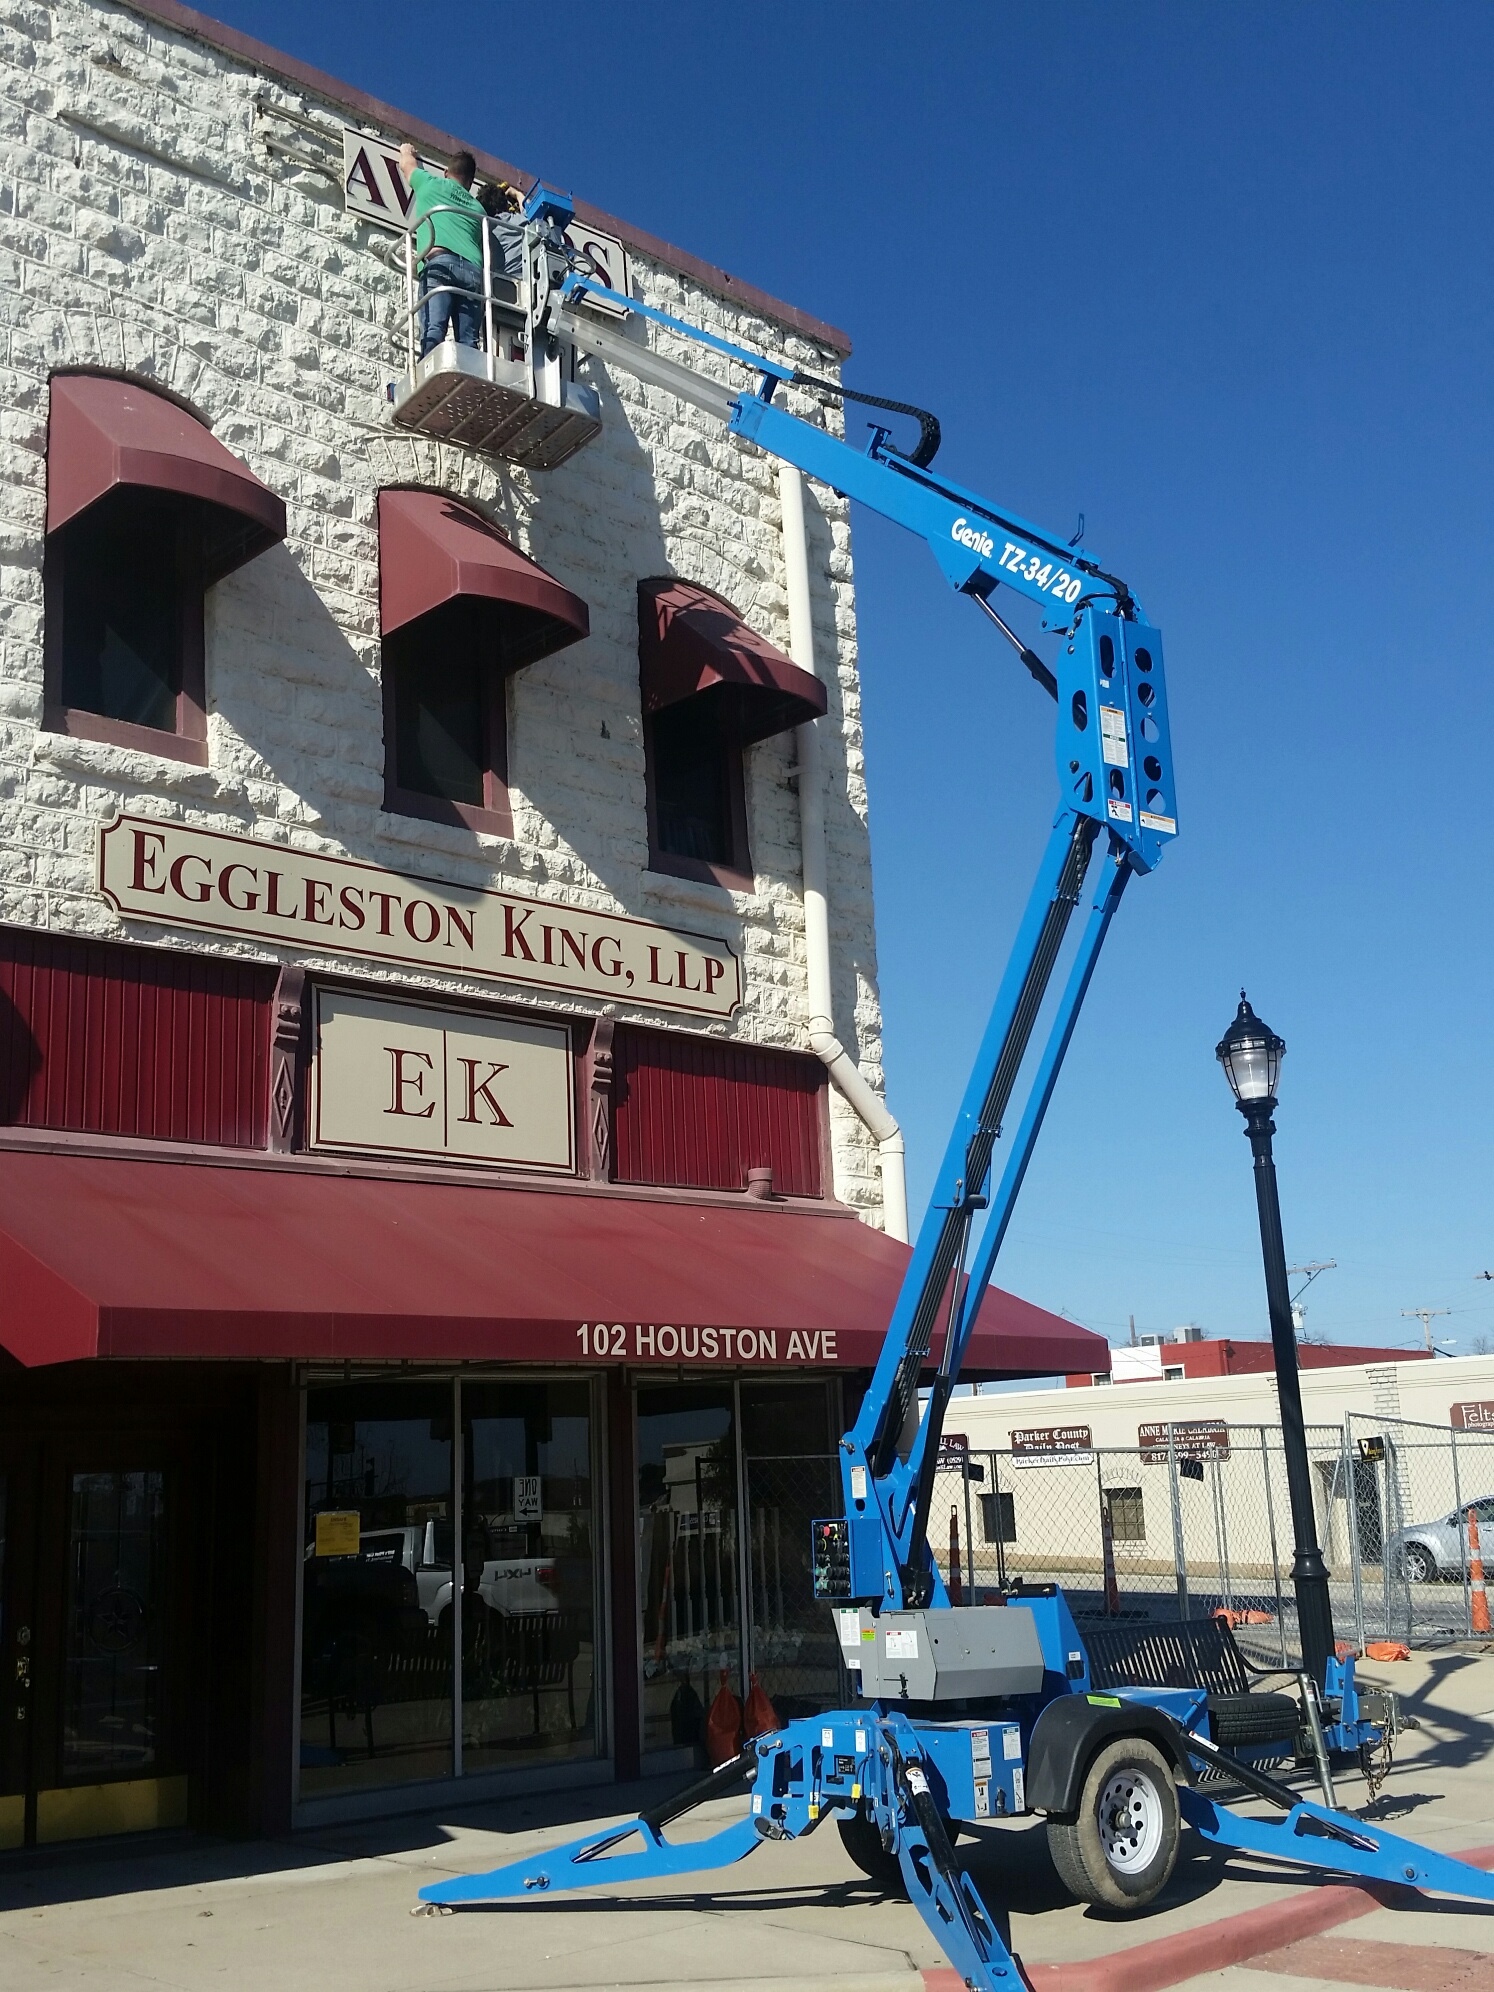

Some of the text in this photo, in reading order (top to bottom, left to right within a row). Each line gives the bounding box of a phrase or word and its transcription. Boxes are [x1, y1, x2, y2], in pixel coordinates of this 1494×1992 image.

[951, 517, 994, 558] Genie
[998, 542, 1082, 603] TZ-34/20
[127, 828, 725, 995] EGGLESTON KING, LLP
[383, 1047, 514, 1127] E K
[576, 1323, 838, 1359] 102 HOUSTON AVE
[1014, 1428, 1089, 1444] Parker County
[1140, 1425, 1161, 1437] ANNE
